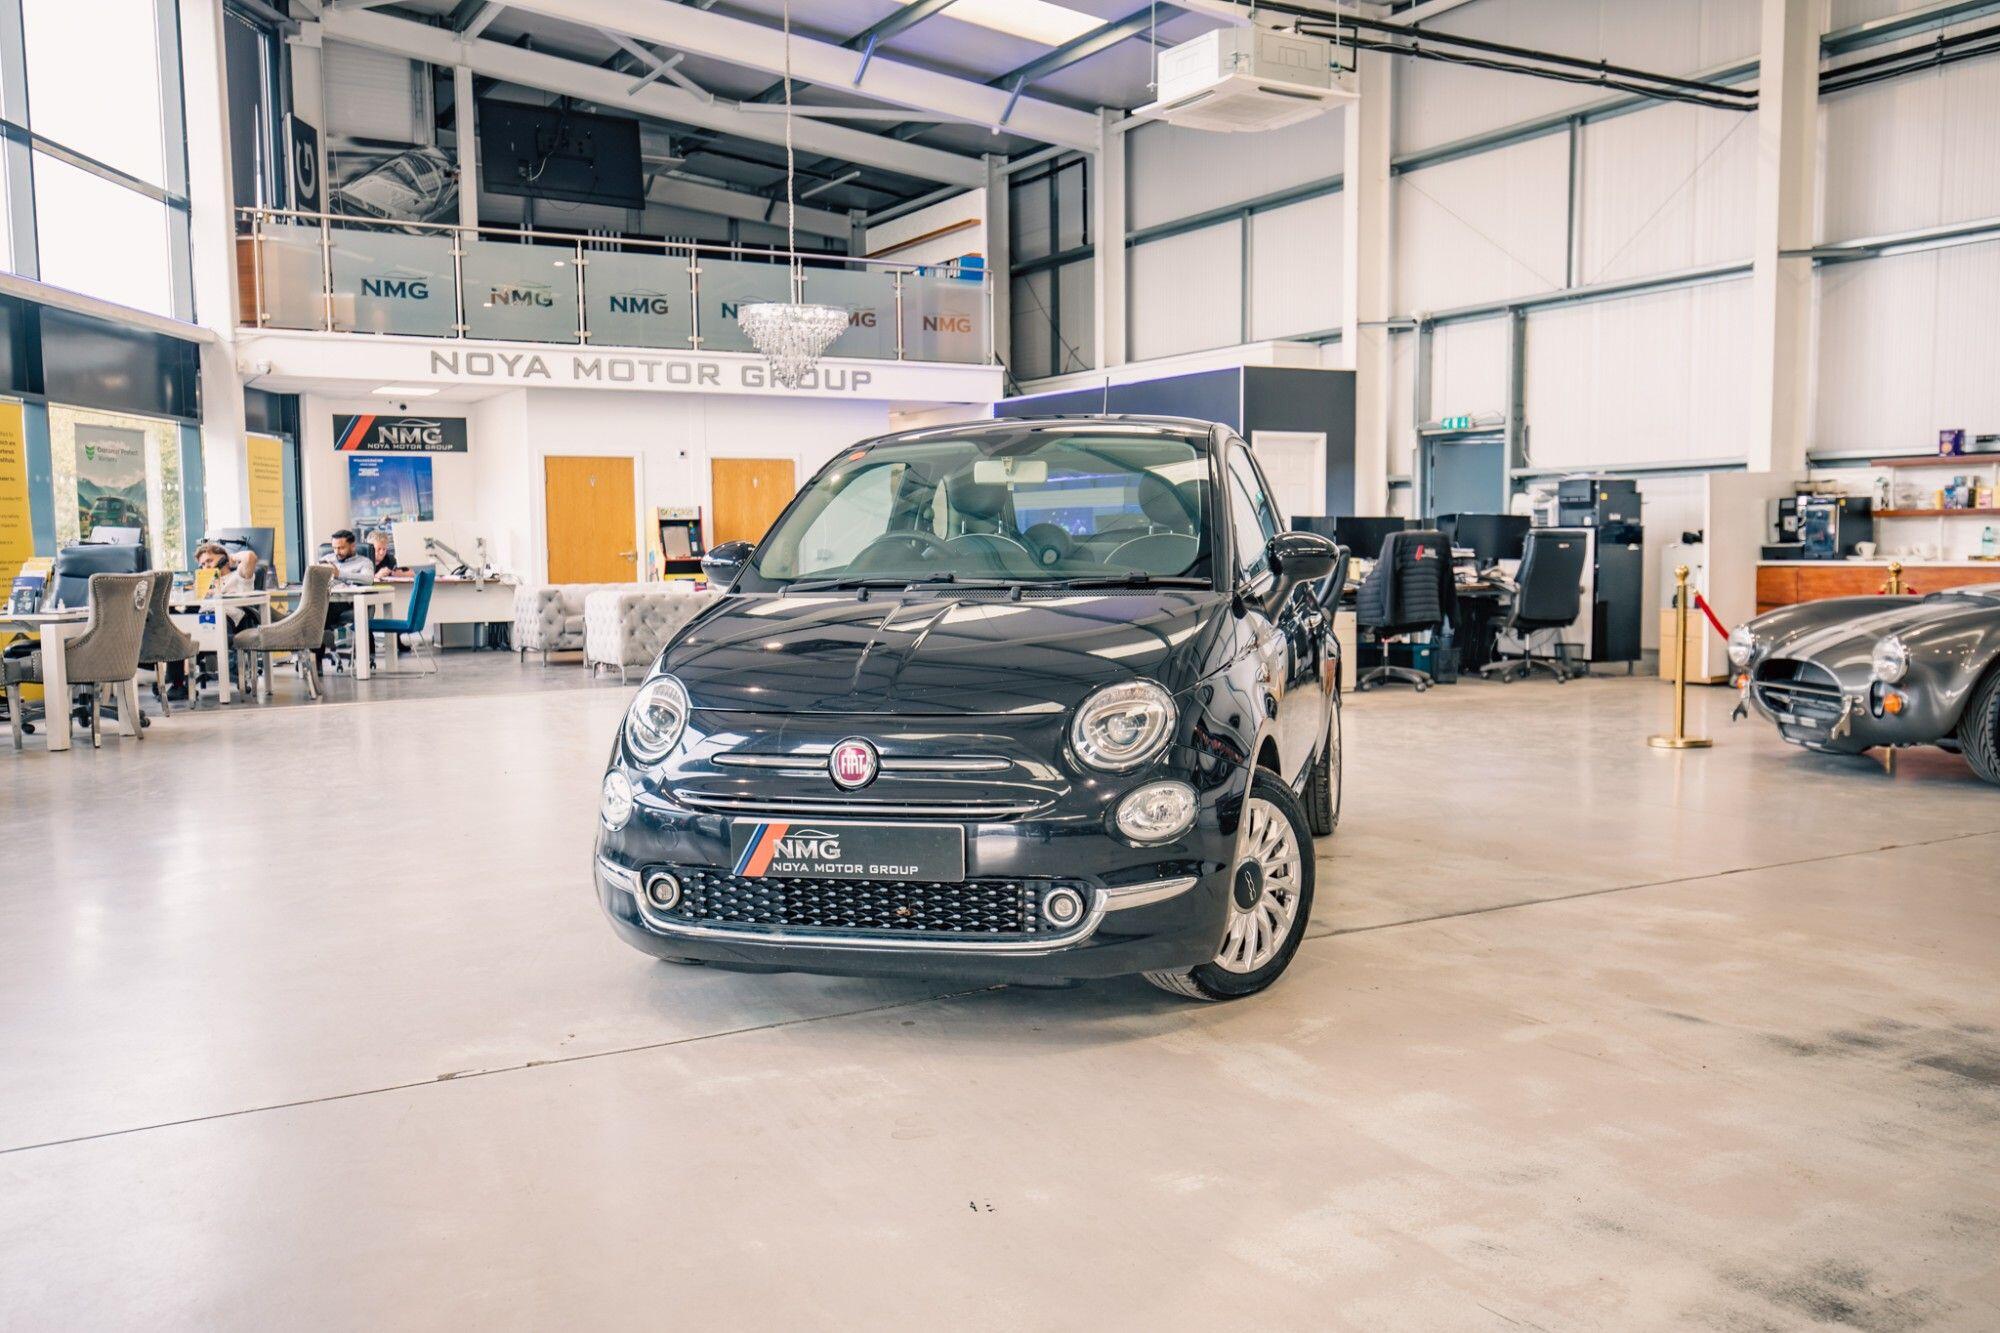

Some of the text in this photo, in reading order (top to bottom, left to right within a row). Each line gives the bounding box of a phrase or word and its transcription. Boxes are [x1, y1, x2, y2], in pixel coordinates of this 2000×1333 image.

[361, 278, 429, 299] NMG
[491, 288, 553, 307] NMG
[609, 296, 668, 315] NMG
[848, 312, 876, 328] MG
[923, 316, 971, 333] NMG
[430, 350, 872, 391] NOYA MOTOR GROUP
[378, 426, 442, 445] NMG
[841, 754, 866, 775] FIAT
[772, 839, 841, 859] NMG
[772, 862, 919, 875] NOYA MOTOR GROUP
